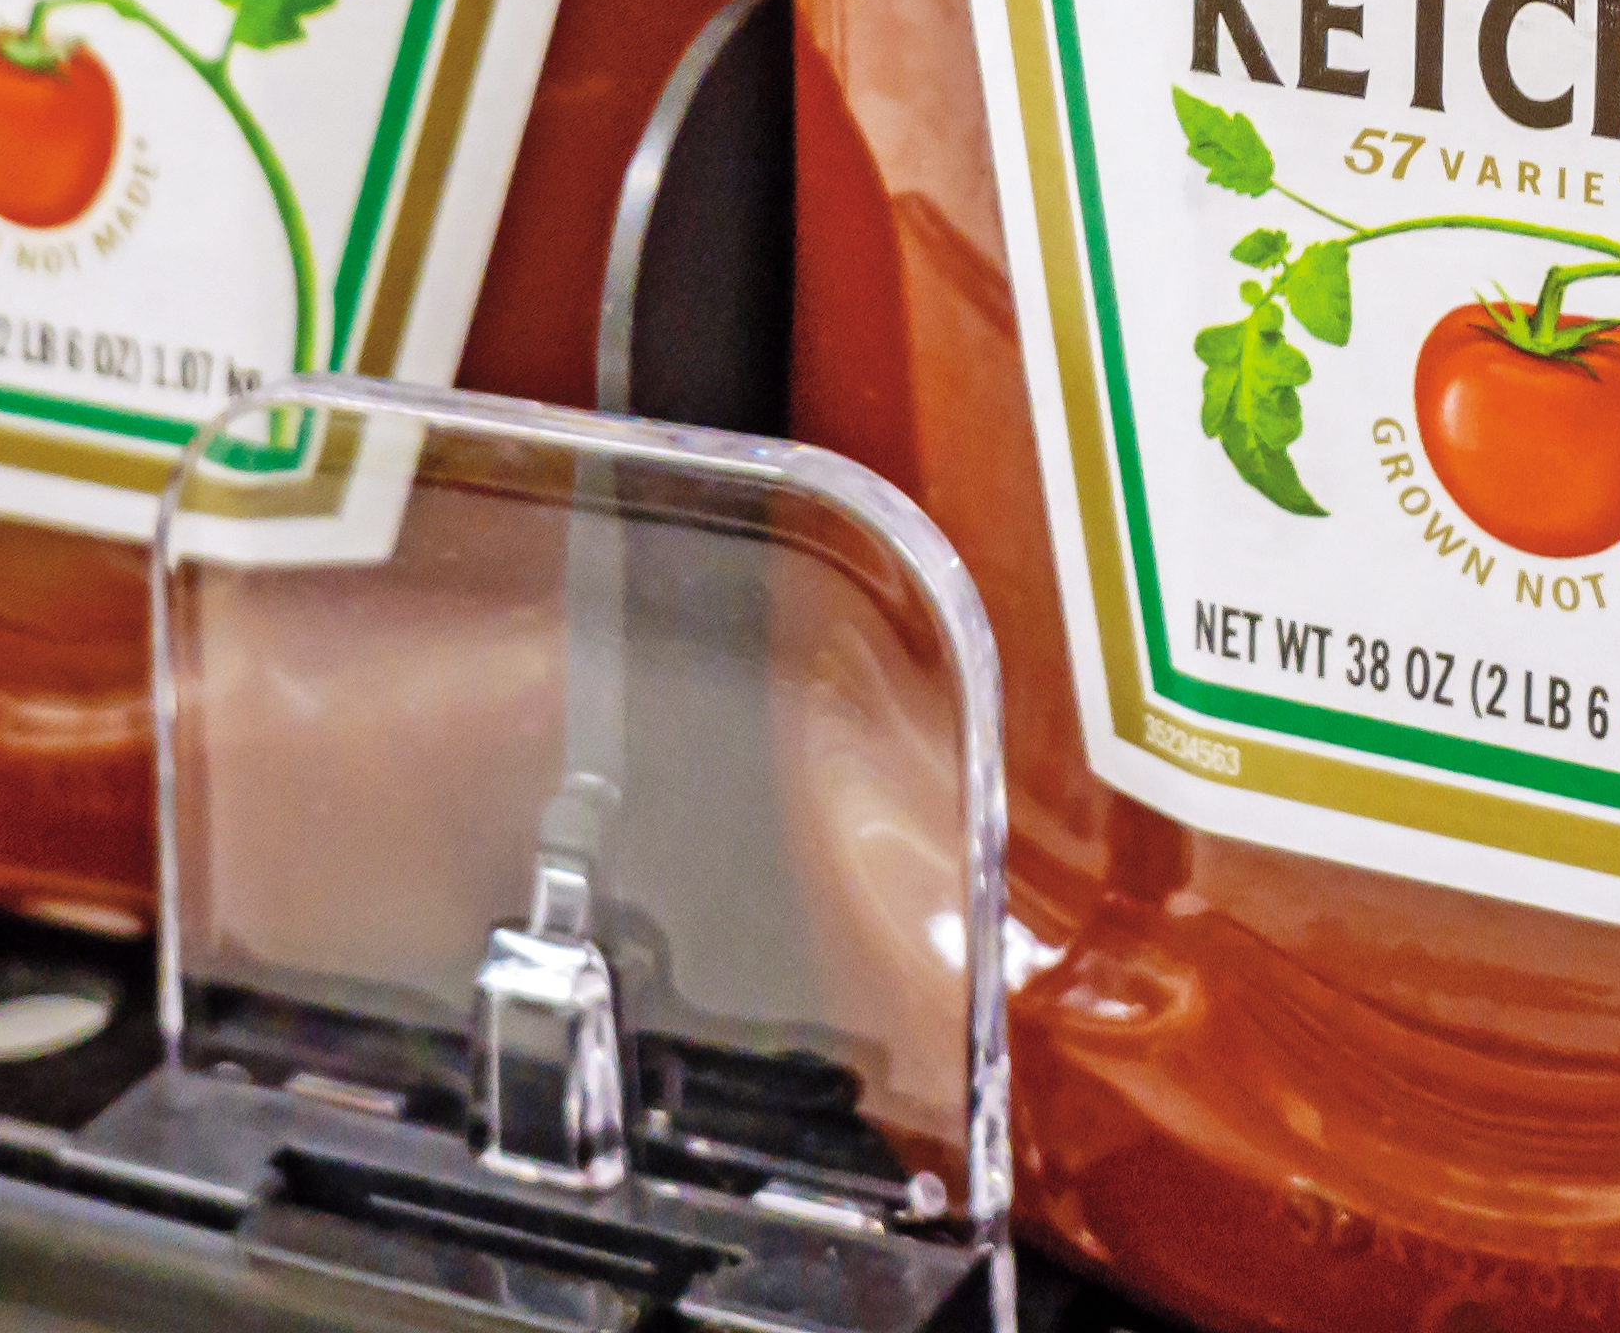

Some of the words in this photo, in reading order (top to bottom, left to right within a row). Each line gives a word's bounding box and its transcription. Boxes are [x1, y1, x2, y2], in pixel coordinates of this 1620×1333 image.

[1343, 127, 1427, 180] 57
[1372, 416, 1497, 587] GROWN
[1515, 569, 1607, 612] NOT
[1195, 598, 1263, 664] NET
[1275, 616, 1333, 679] WT
[1345, 632, 1391, 693] 38
[1405, 645, 1456, 707] OZ
[1470, 658, 1509, 719] (2
[1523, 670, 1572, 731] LB
[1587, 685, 1609, 740] 6
